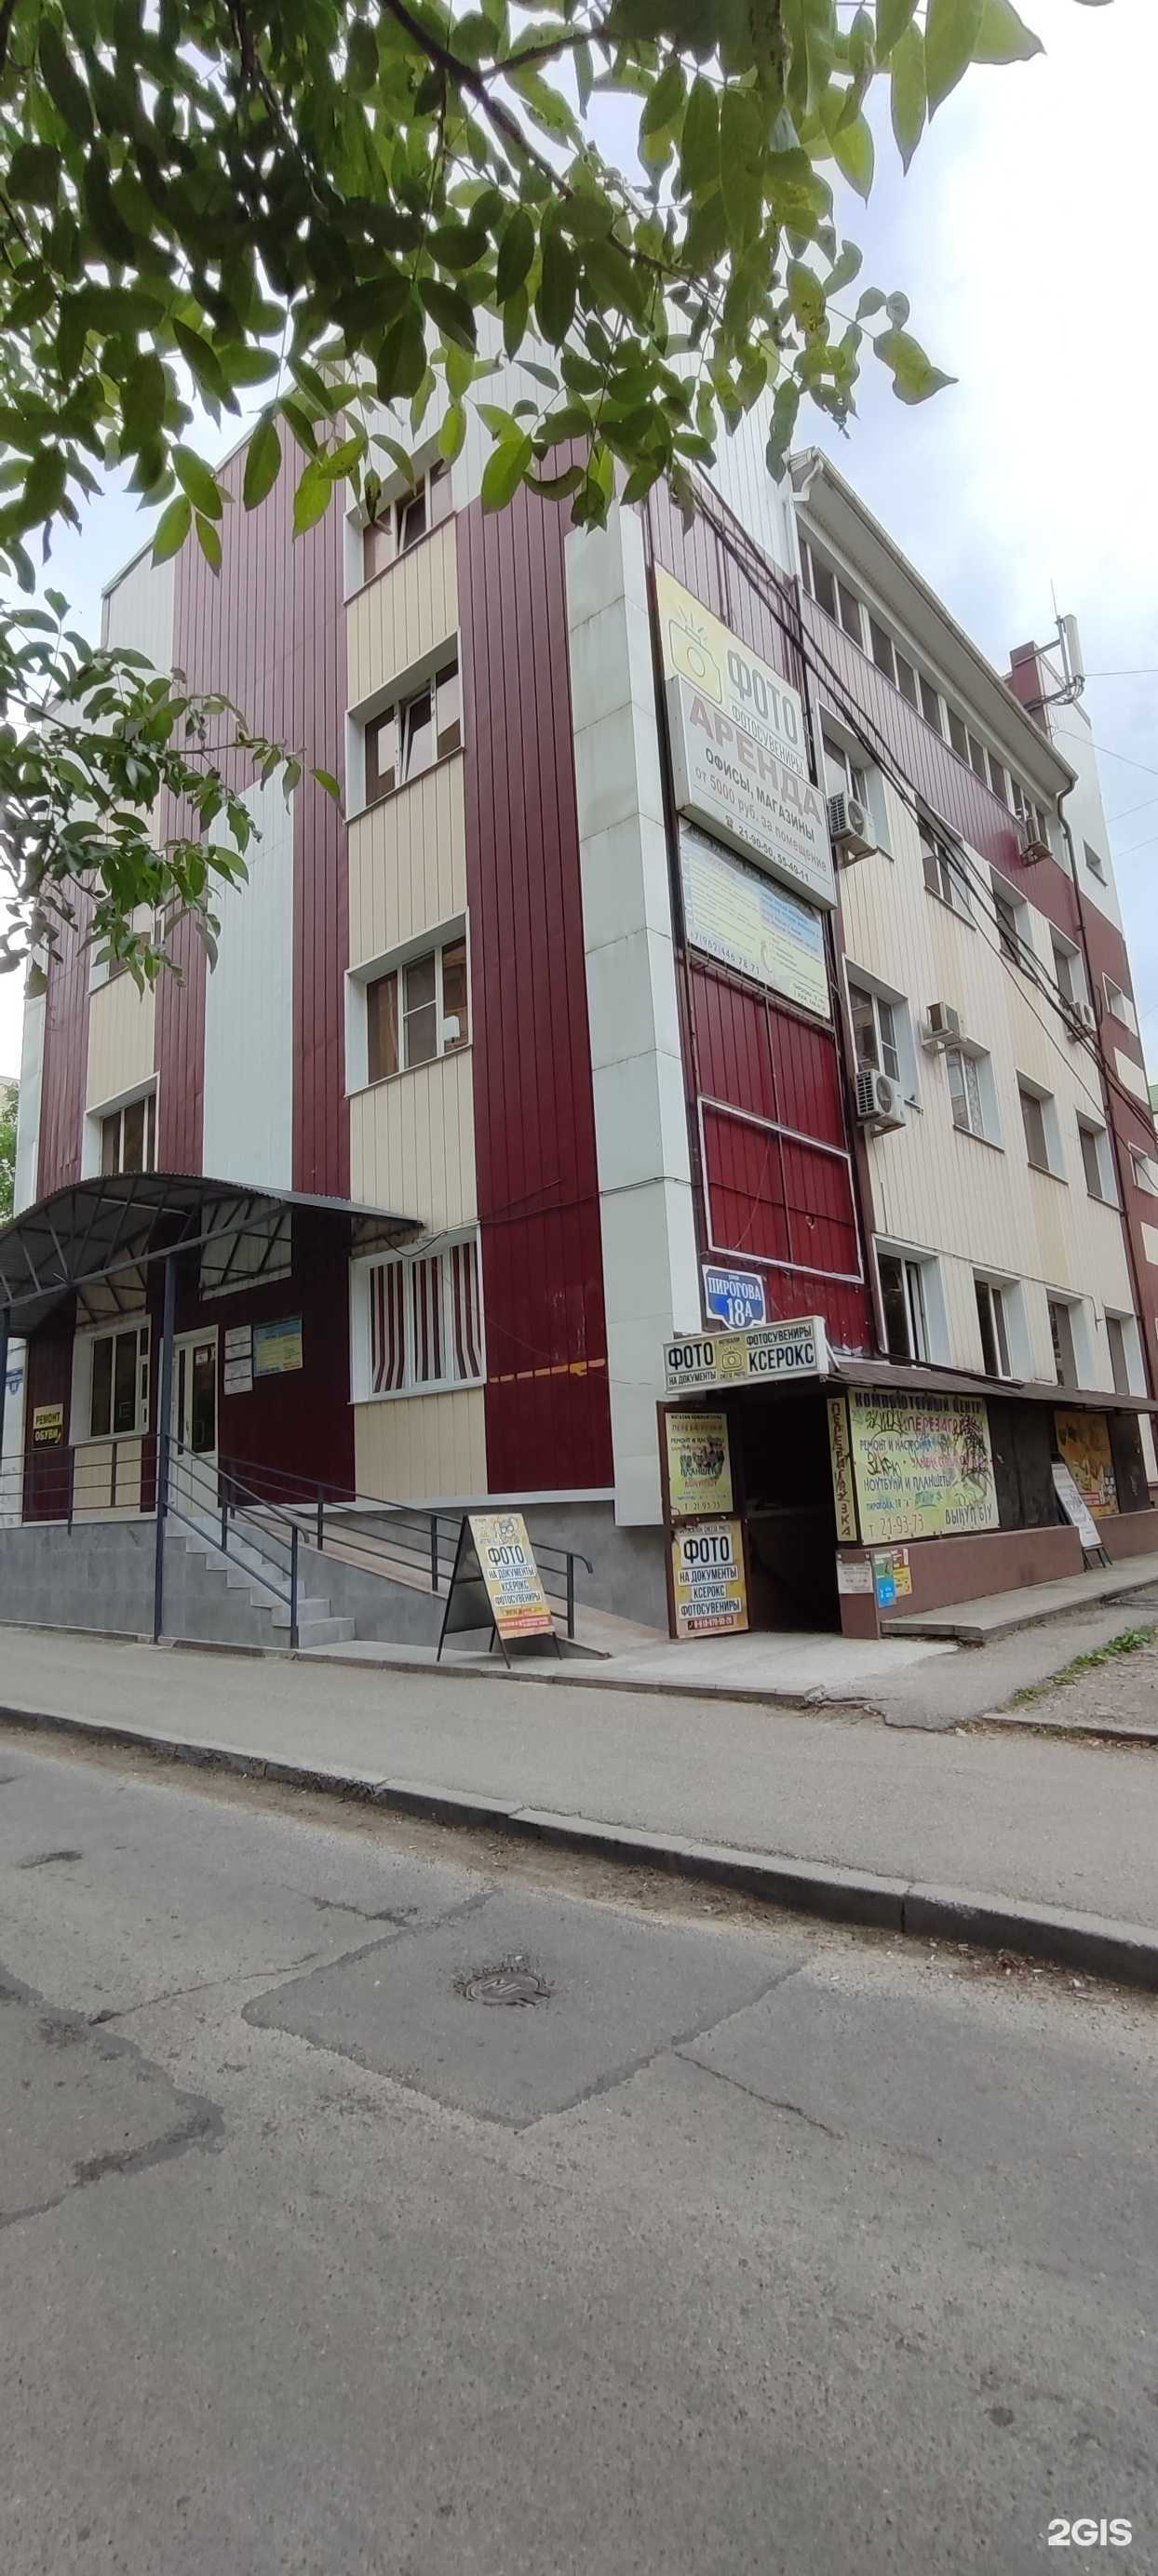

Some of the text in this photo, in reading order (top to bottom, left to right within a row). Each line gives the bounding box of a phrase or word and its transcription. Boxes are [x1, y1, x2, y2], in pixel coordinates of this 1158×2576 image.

[727, 650, 798, 745] ФОТО
[732, 704, 804, 776] ФОТОСУВЕНИРЫ
[689, 695, 822, 826] АРЕНДА
[706, 747, 815, 843] ОФИСЫ, МАГАЗИНЫ
[710, 773, 735, 804] 5000
[707, 1277, 762, 1301] ПИРОГОВА
[747, 1325, 812, 1347] ФОТОСУВЕНИРЫ
[668, 1342, 714, 1371] ФОТО
[748, 1343, 815, 1373] КСЕРОКС
[668, 1371, 716, 1386] НА ДОКУМЕНТЫ
[880, 1513, 924, 1536] 21-93-73
[488, 1545, 525, 1565] ФОТО
[683, 1536, 730, 1564] ФОТО
[489, 1565, 535, 1579] НА ДОКУМЕНТЫ
[680, 1566, 737, 1583] НА ДОКУМЕНТЫ
[502, 1580, 529, 1591] КСЕРОКС
[693, 1585, 725, 1599] КСЕРОКС
[495, 1592, 541, 1605] ФОТОСУВЕНИРЫ
[680, 1600, 740, 1617] ФОТОСУВЕНИРЫ
